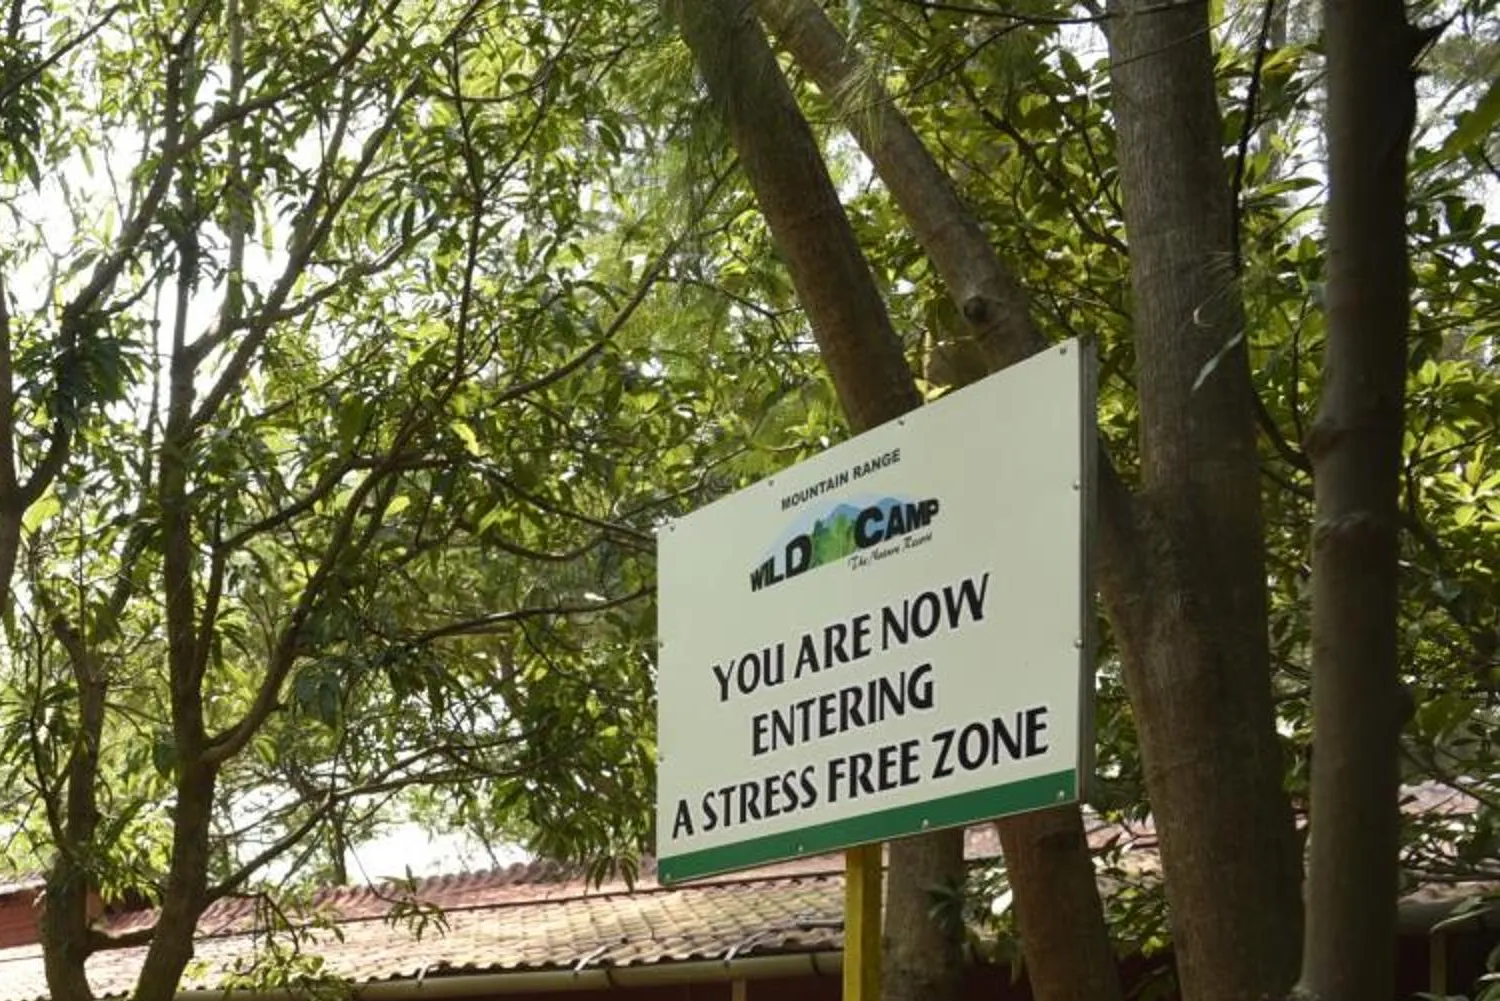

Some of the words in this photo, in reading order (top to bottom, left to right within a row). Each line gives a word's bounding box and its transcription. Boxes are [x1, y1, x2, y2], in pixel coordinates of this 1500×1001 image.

[782, 471, 849, 511] MOUNTAIN
[853, 448, 900, 480] RANGE
[750, 534, 812, 592] WILD
[854, 498, 939, 548] CAMP
[712, 644, 785, 701] YOU
[794, 614, 871, 679] ARE
[881, 573, 990, 650] NOW
[752, 663, 934, 756] ENTERING
[672, 800, 694, 839] A
[702, 765, 817, 831] STRESS
[828, 739, 920, 802] FREE
[931, 706, 1049, 779] ZONE
